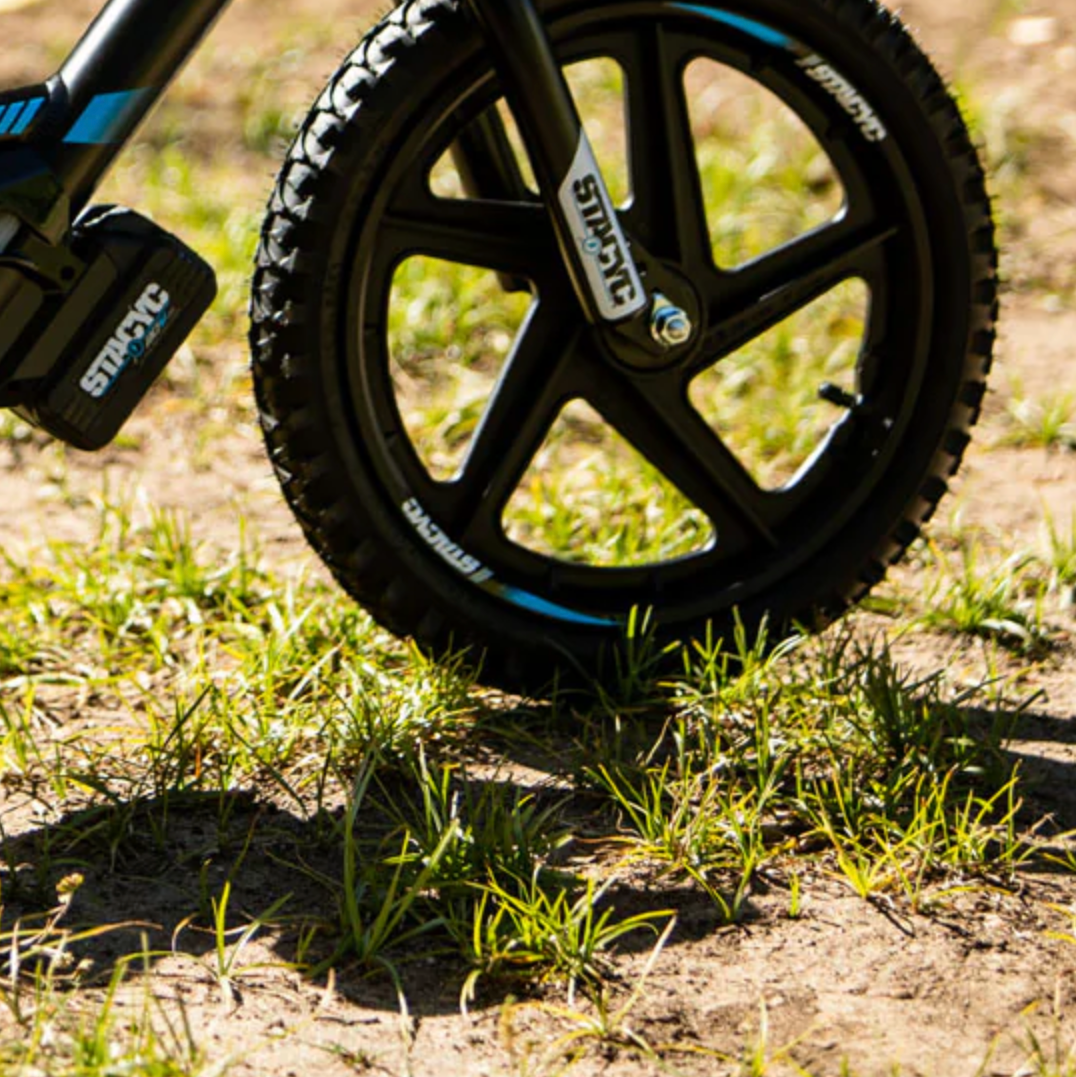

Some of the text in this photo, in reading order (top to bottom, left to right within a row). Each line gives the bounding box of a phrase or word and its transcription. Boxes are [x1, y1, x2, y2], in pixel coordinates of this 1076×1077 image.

[805, 64, 887, 141] STACYC
[573, 173, 637, 306] STACYC
[80, 283, 169, 398] STACYC
[401, 497, 482, 574] STACYC
